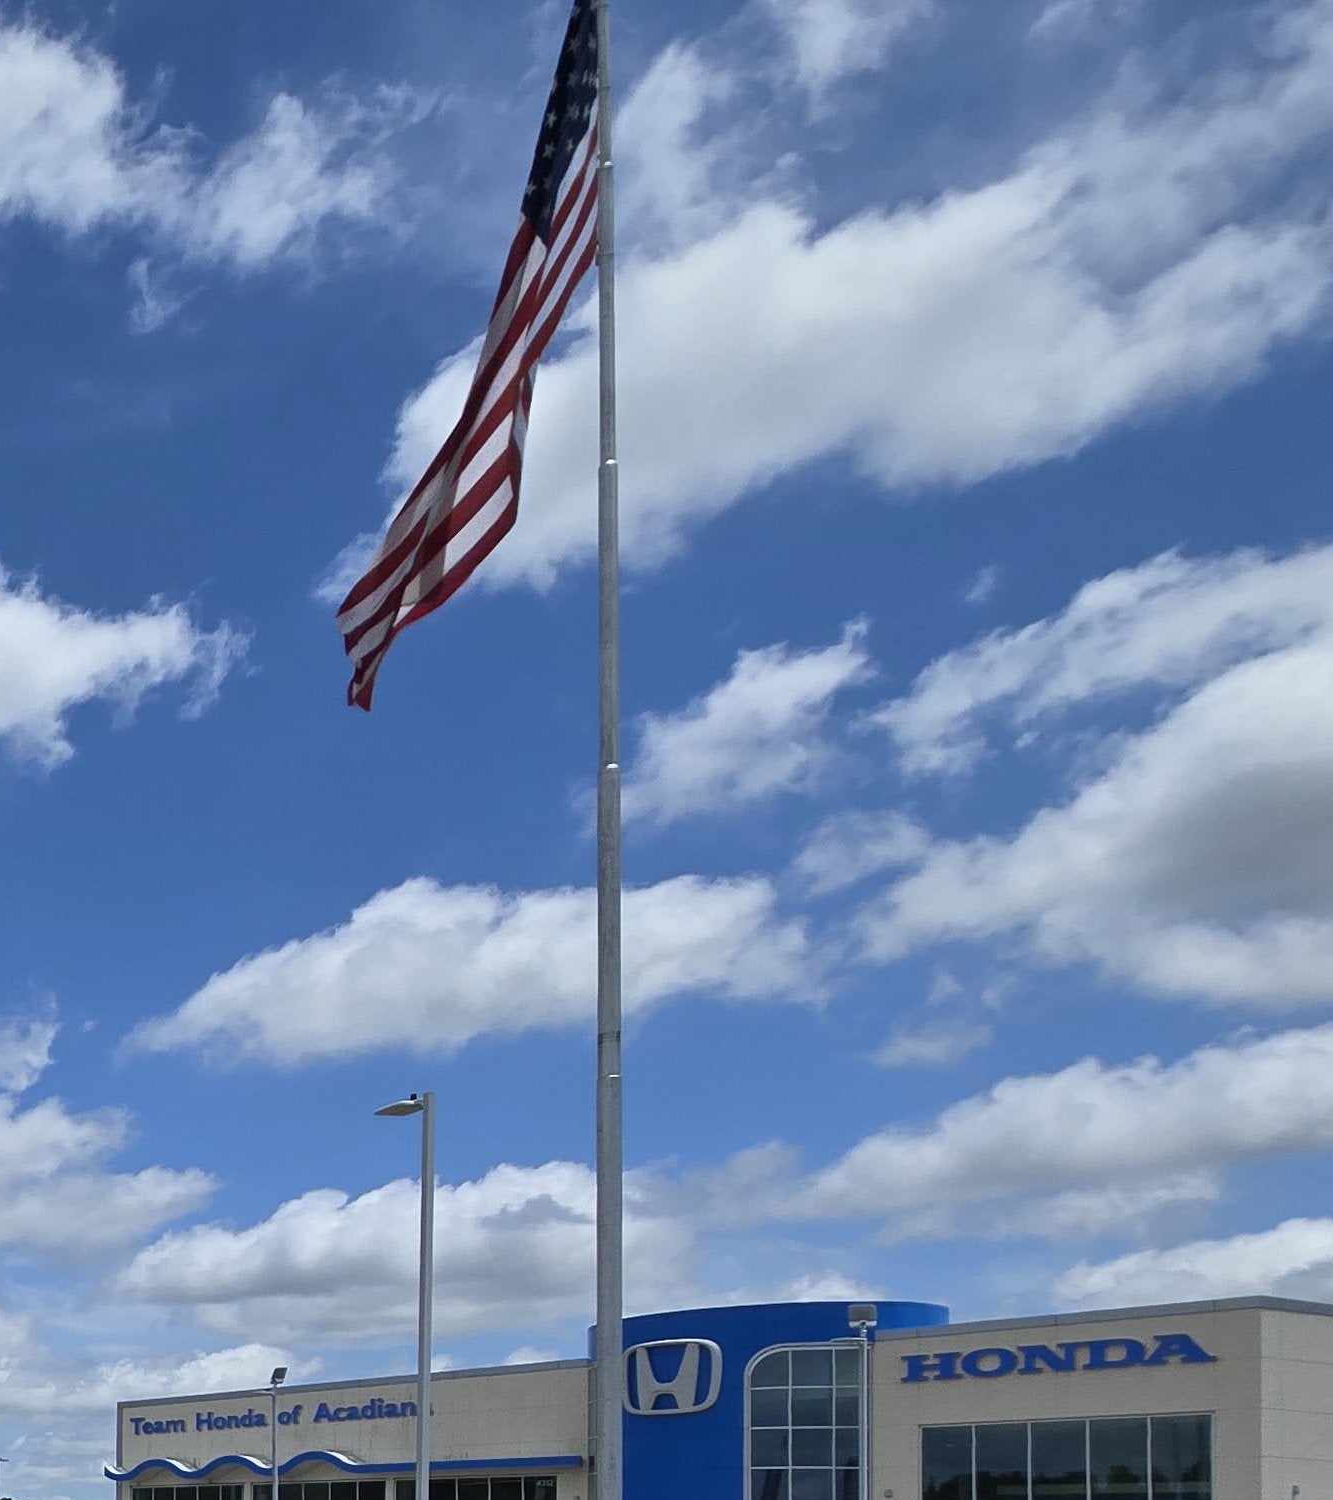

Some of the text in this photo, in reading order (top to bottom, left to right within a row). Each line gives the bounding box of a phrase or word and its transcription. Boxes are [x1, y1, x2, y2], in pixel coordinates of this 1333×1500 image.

[900, 1332, 1217, 1383] HONDA
[130, 1397, 434, 1436] Team Honda of Acadian
